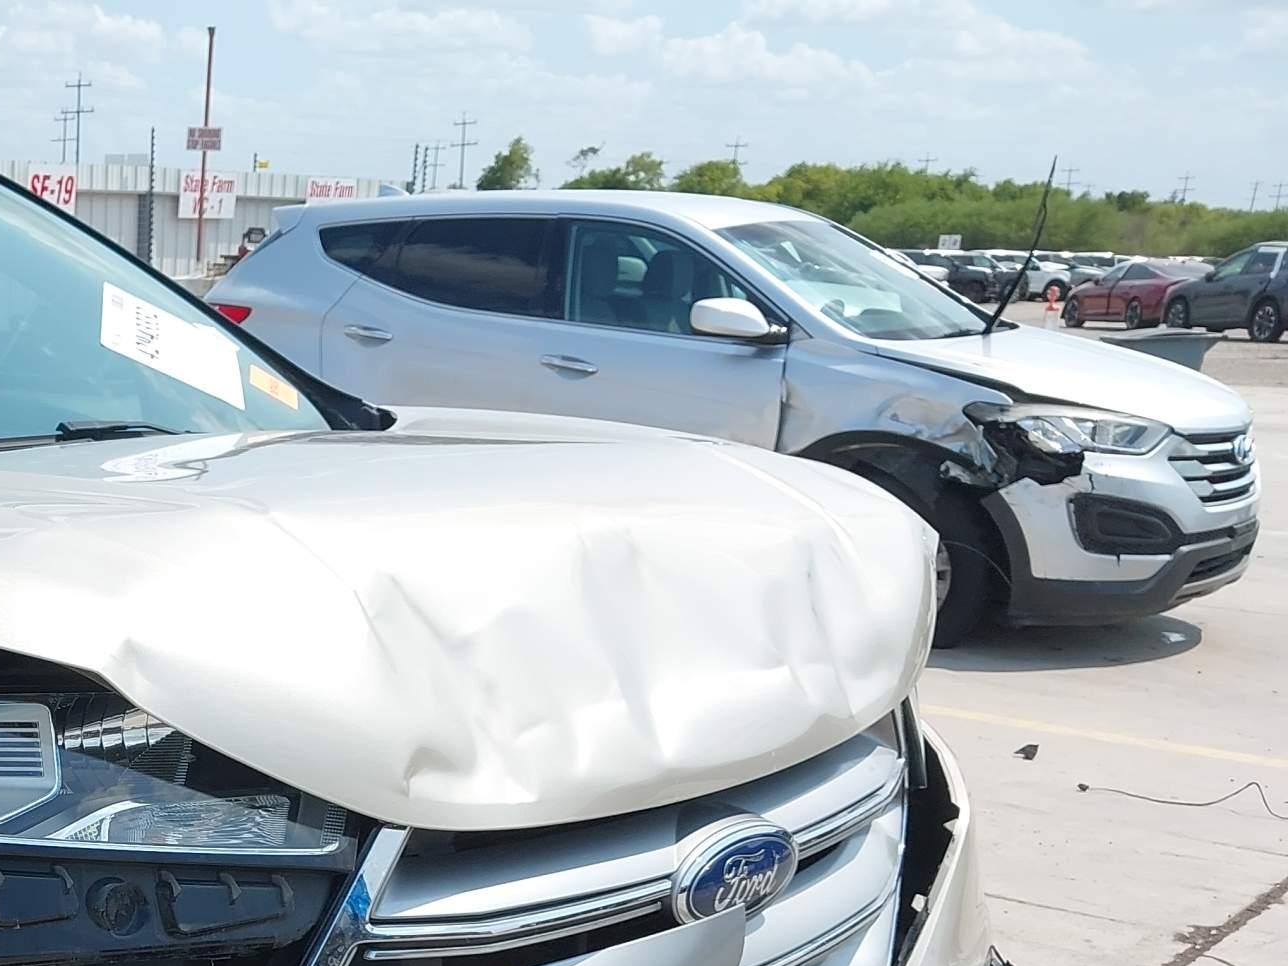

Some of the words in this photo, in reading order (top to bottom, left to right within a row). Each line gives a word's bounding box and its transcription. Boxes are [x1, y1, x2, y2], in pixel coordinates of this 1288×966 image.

[31, 174, 75, 205] SF-19
[183, 174, 209, 193] Stae
[211, 175, 233, 193] Farm
[334, 180, 353, 198] Farm
[714, 850, 780, 912] Ford
